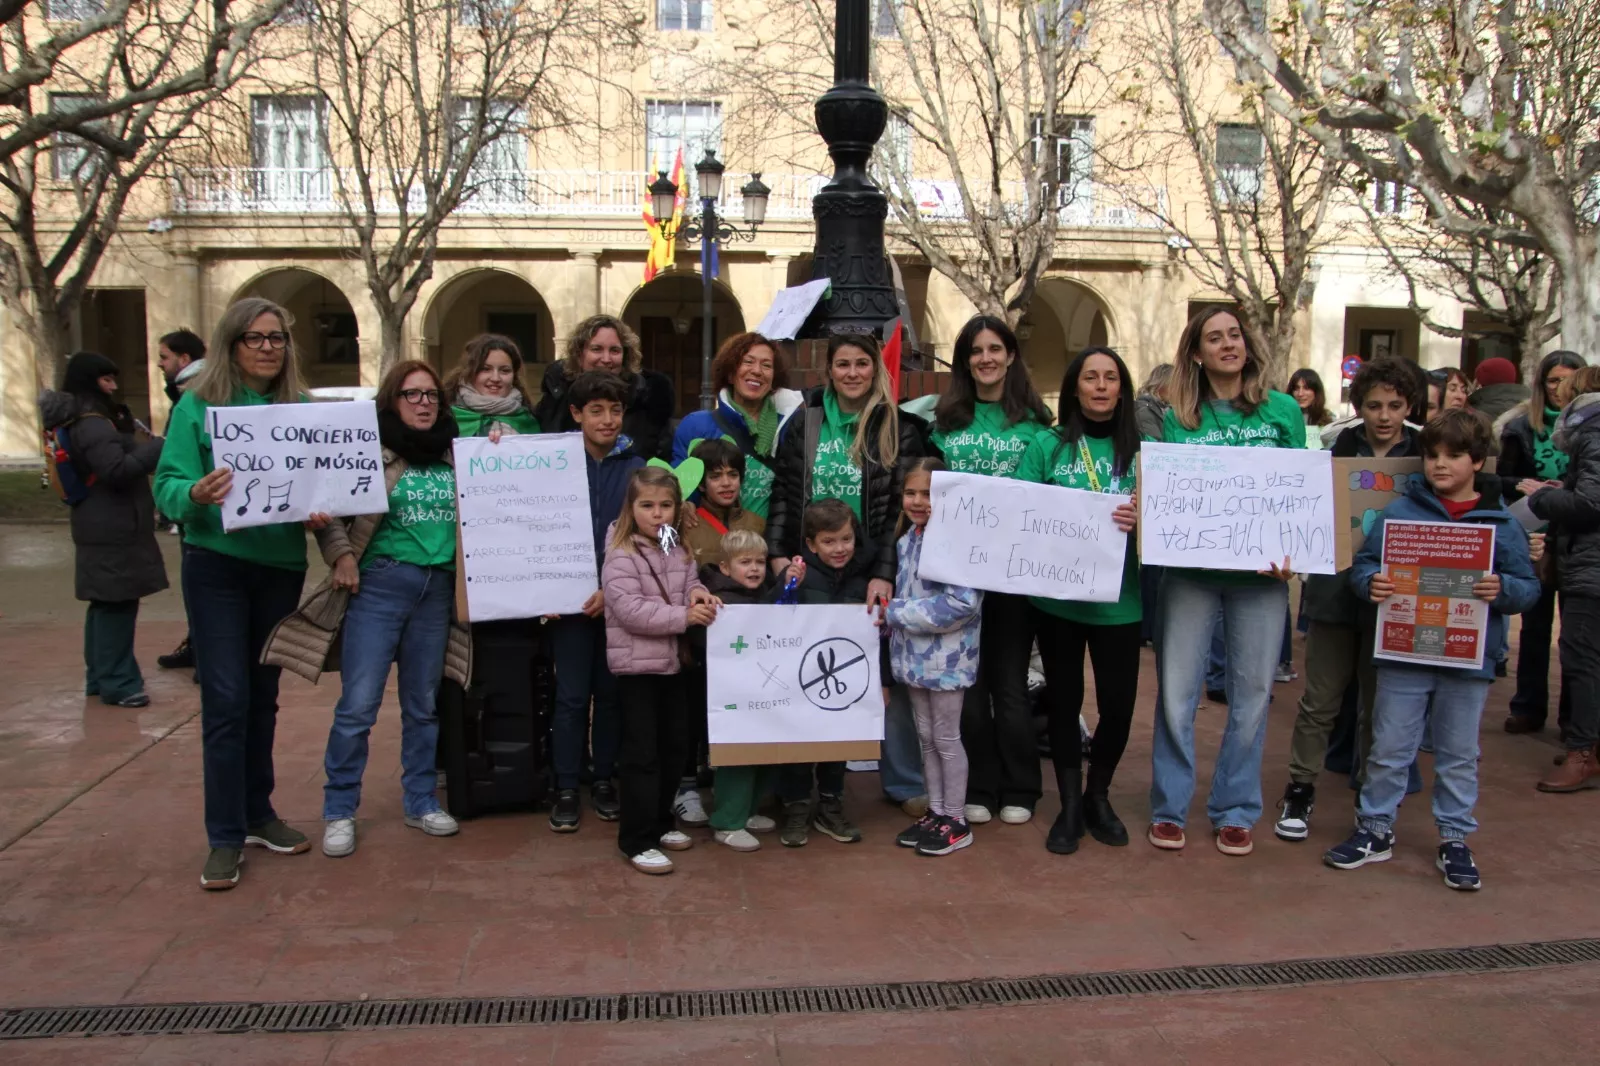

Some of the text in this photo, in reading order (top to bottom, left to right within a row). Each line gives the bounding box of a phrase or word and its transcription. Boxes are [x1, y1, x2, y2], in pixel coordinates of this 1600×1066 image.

[212, 411, 378, 445] LOS CONCIERTOS
[944, 433, 1027, 452] ESCUELA PÚBLICA
[221, 451, 379, 473] SOLO DE MÚSICA
[469, 450, 569, 477] MONZÓN 3
[951, 459, 967, 470] DE
[1054, 459, 1103, 476] ESCUEA
[1261, 471, 1306, 491] ESTÁ
[406, 489, 425, 501] DE
[466, 483, 523, 498] PERSONAL
[496, 494, 578, 508] ADMINISTRATIVO
[1144, 494, 1323, 521] LUCHANDO TAMBIÉN
[401, 509, 435, 522] PARA
[467, 511, 572, 528] COCINA ESCOLAR
[528, 522, 571, 533] PROPIA
[1019, 509, 1100, 542] INVERSIÓN
[1451, 527, 1479, 535] dinero
[1156, 518, 1264, 557] MAESTRA
[1388, 532, 1419, 540] público
[1426, 533, 1435, 541] la
[1436, 535, 1483, 544] concertada
[472, 546, 527, 559] ARREGLO
[532, 544, 547, 554] DE
[1409, 541, 1450, 550] supondría
[524, 553, 593, 565] FRECUENTES
[968, 545, 988, 565] EN
[1387, 548, 1429, 556] educación
[1430, 549, 1461, 558] pública
[1387, 555, 1420, 564] Aragón?
[533, 571, 598, 581] PERSONALIZADA
[1460, 575, 1474, 584] 50
[1423, 602, 1442, 611] 247
[1448, 634, 1475, 643] 4000
[748, 697, 791, 711] RECORTES
